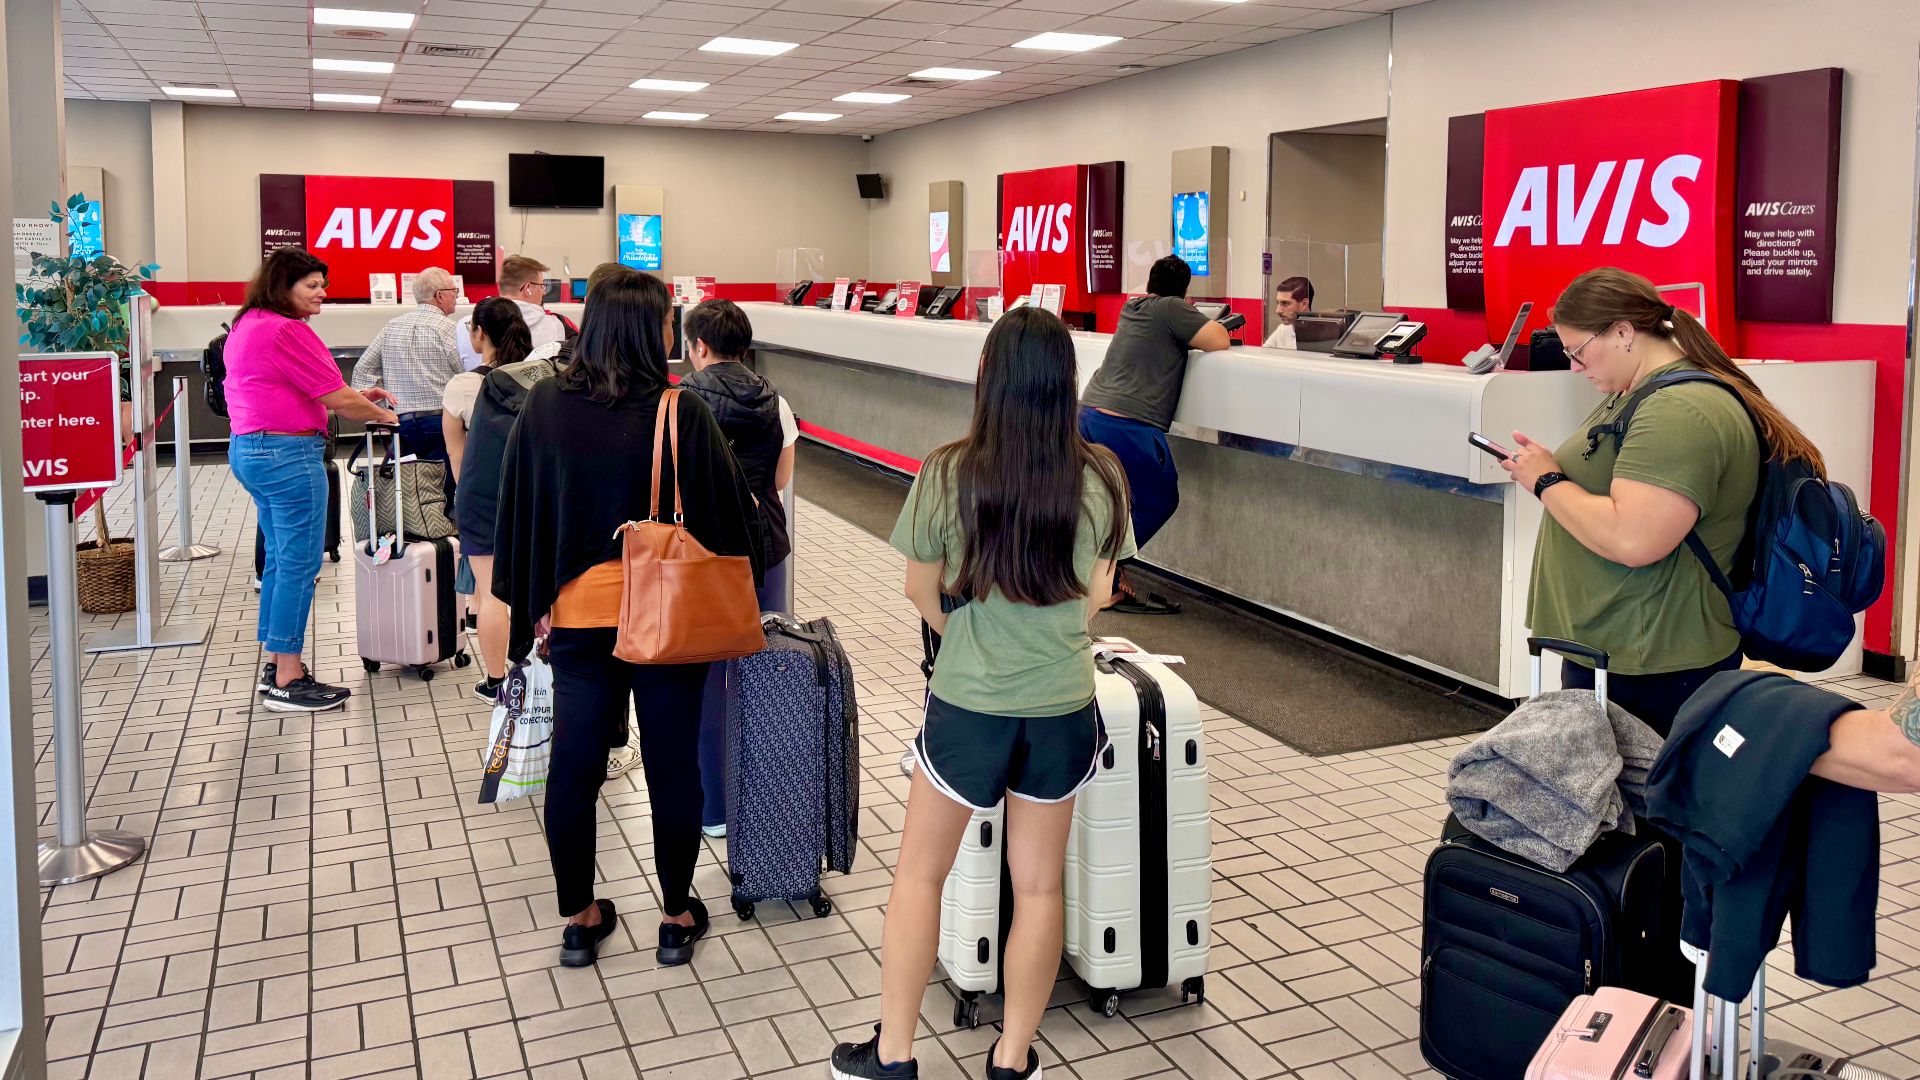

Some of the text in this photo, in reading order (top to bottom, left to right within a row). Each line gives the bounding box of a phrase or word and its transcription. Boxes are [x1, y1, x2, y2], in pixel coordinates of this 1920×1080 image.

[1494, 154, 1702, 248] AVIS
[314, 207, 446, 250] AVIS
[1006, 202, 1072, 254] AVIS
[1744, 230, 1761, 239] May
[1778, 229, 1795, 239] help
[1798, 229, 1815, 237] with
[1757, 238, 1801, 247] directions?
[1742, 258, 1765, 267] adjust
[1768, 259, 1785, 267] your
[1786, 267, 1812, 277] safely.
[19, 370, 88, 384] tart your
[20, 388, 40, 404] ip.
[20, 414, 100, 428] nter here.
[269, 687, 289, 698] HOKA
[487, 738, 511, 773] tech
